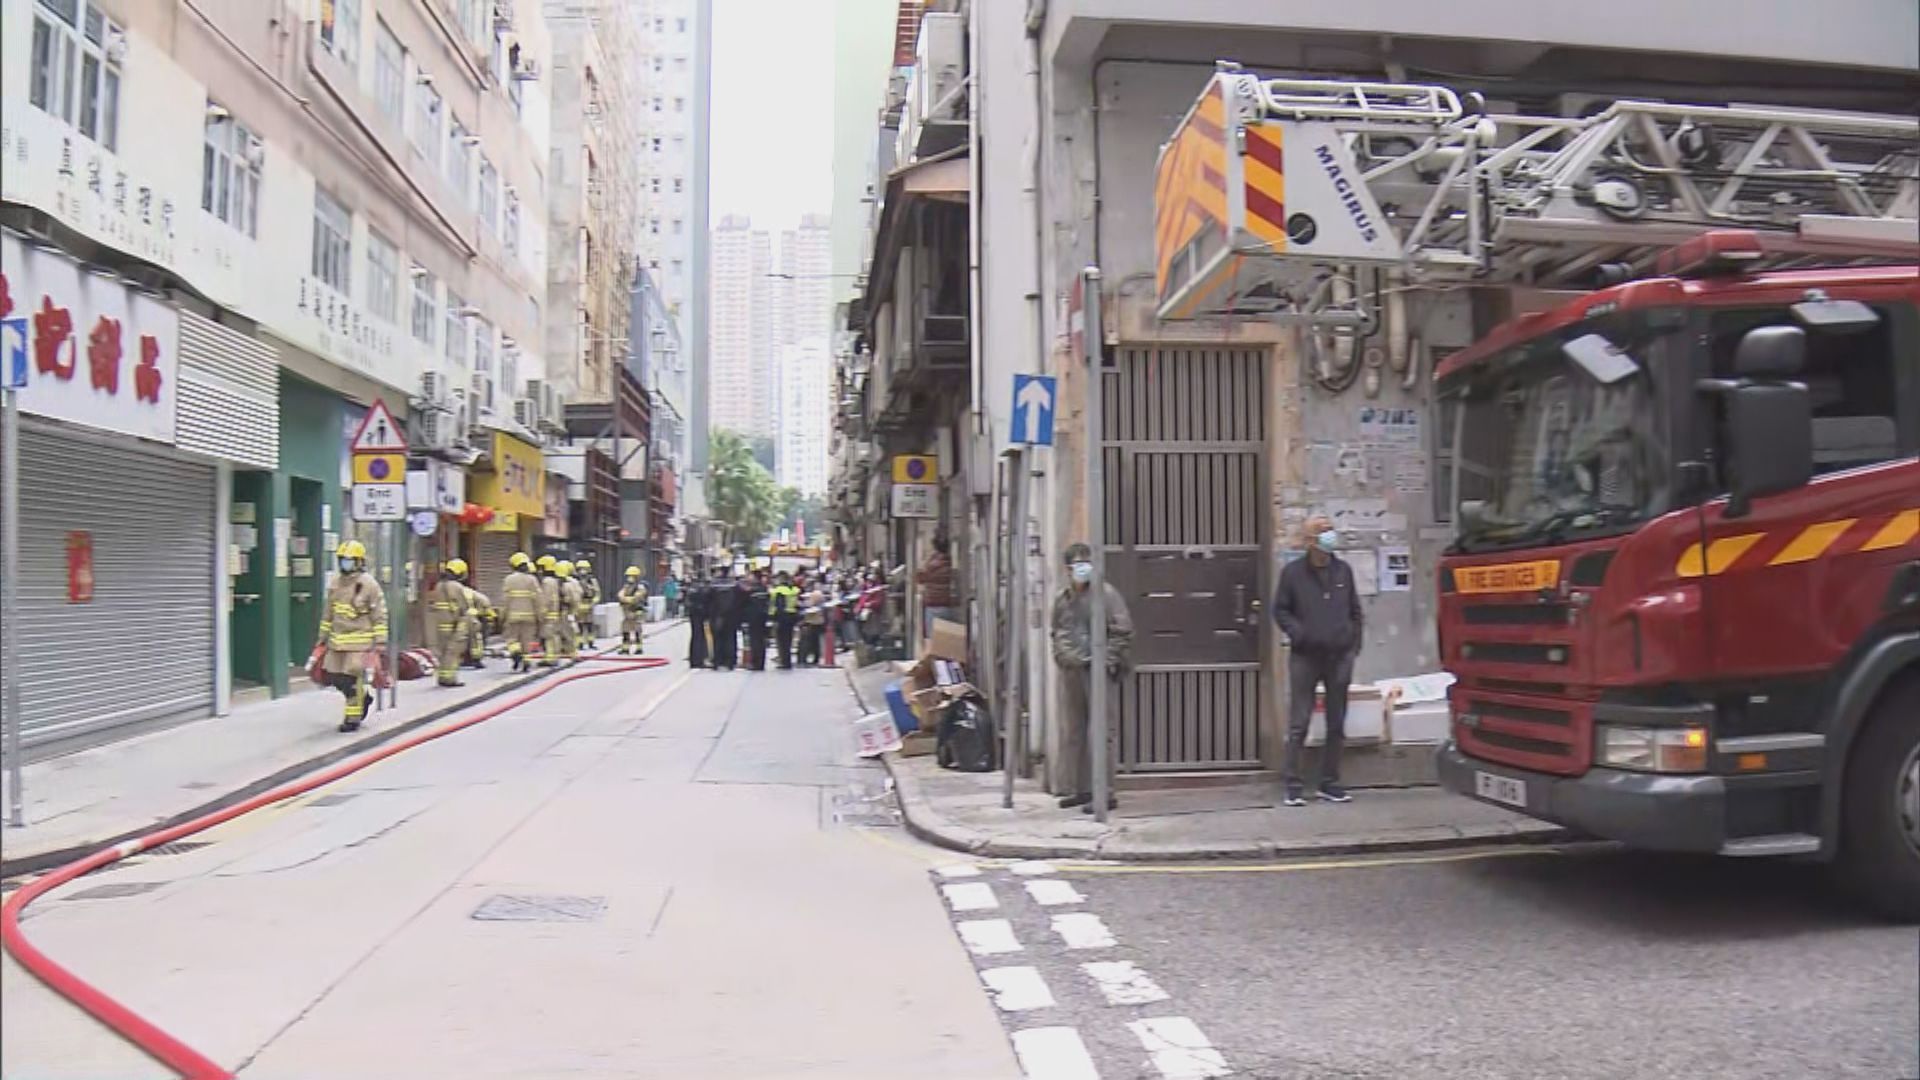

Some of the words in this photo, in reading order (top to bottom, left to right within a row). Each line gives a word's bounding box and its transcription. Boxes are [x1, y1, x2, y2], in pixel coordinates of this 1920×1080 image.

[1315, 145, 1379, 243] MAGIRUS
[368, 487, 392, 499] End
[1468, 570, 1488, 589] FIRE
[1489, 566, 1536, 588] SERVICES
